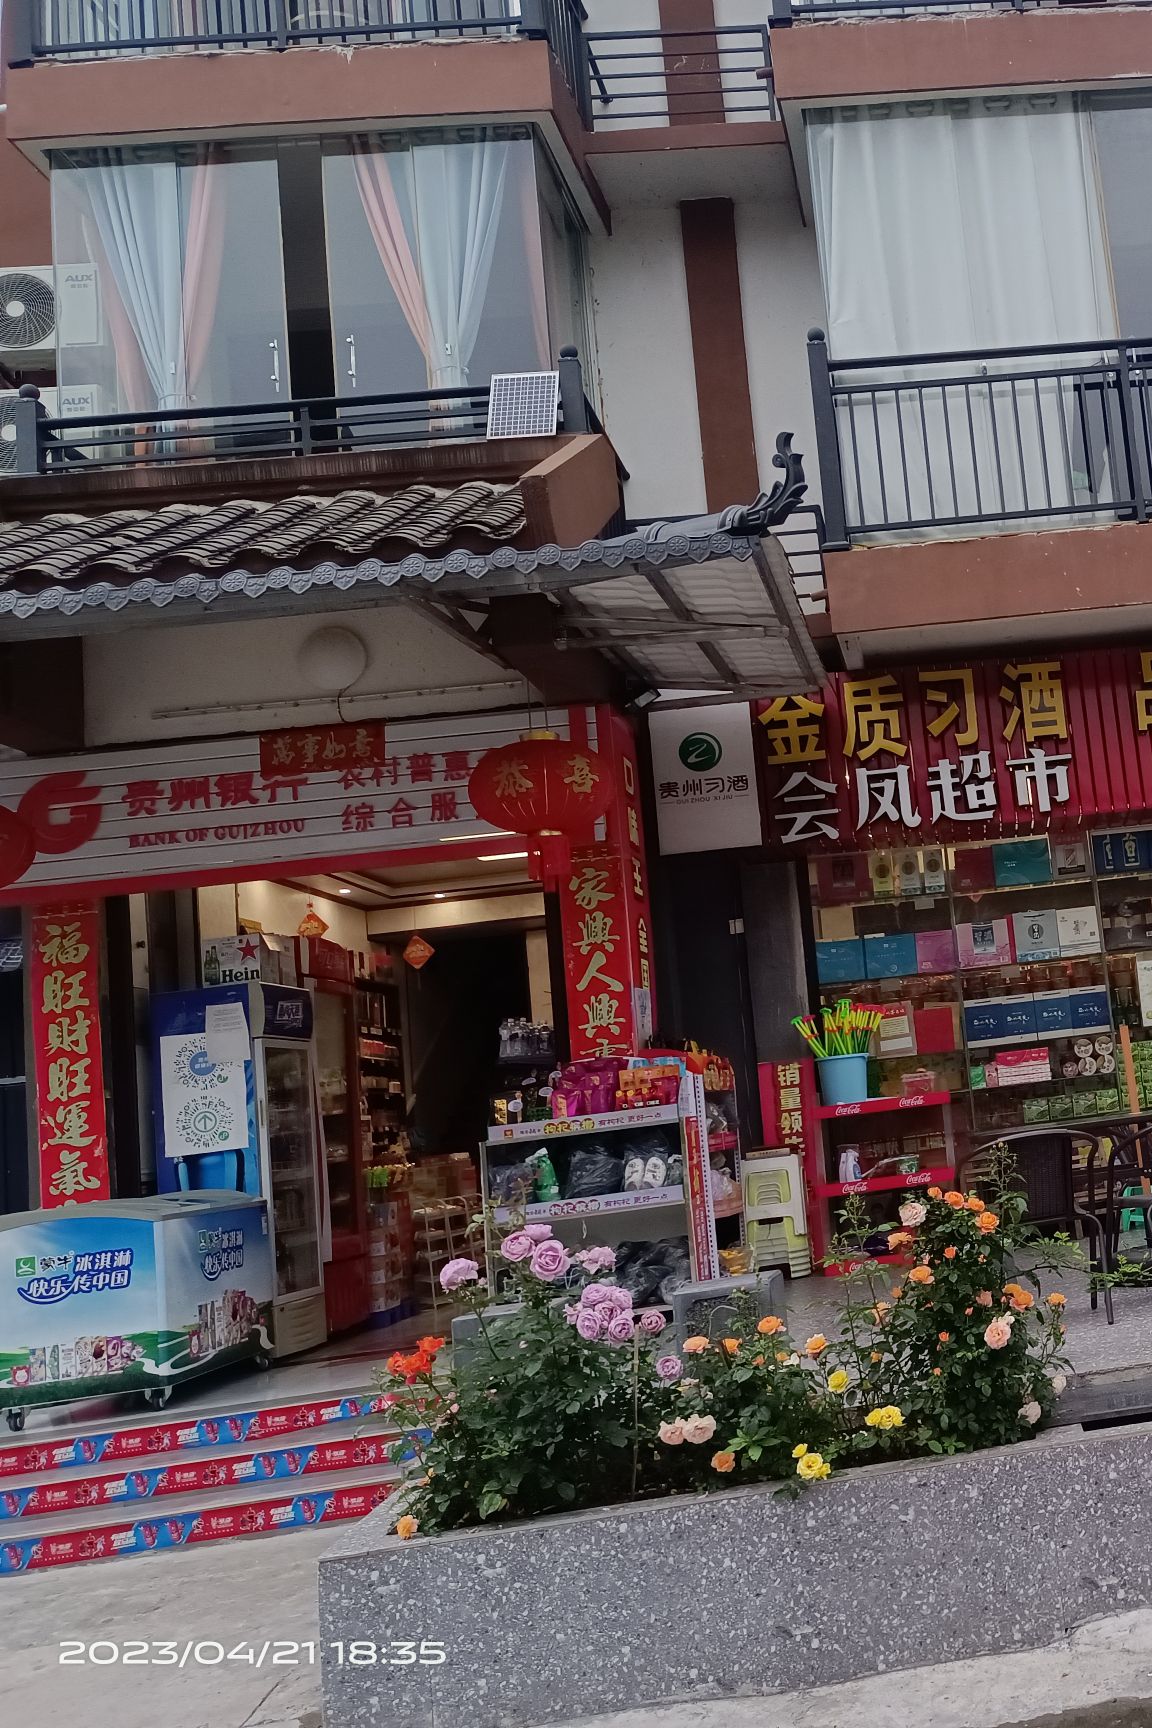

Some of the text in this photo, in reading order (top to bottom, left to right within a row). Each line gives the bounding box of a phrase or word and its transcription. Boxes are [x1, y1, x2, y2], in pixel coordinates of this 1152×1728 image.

[65, 274, 93, 282] AUX
[63, 396, 90, 405] AUX
[758, 661, 1071, 765] 金质习酒
[336, 751, 482, 791] 农村普惠
[659, 775, 749, 800] 贵州习酒
[773, 747, 1073, 845] 会凤超市
[341, 791, 481, 832] 综合服
[129, 818, 305, 849] BANK OF GUIZHOU
[221, 967, 260, 983] Hein
[41, 922, 101, 1208] 福旺財旺運氣
[40, 1250, 132, 1272] 蒙牛 冰淇淋
[25, 1270, 129, 1301] 快乐传中国
